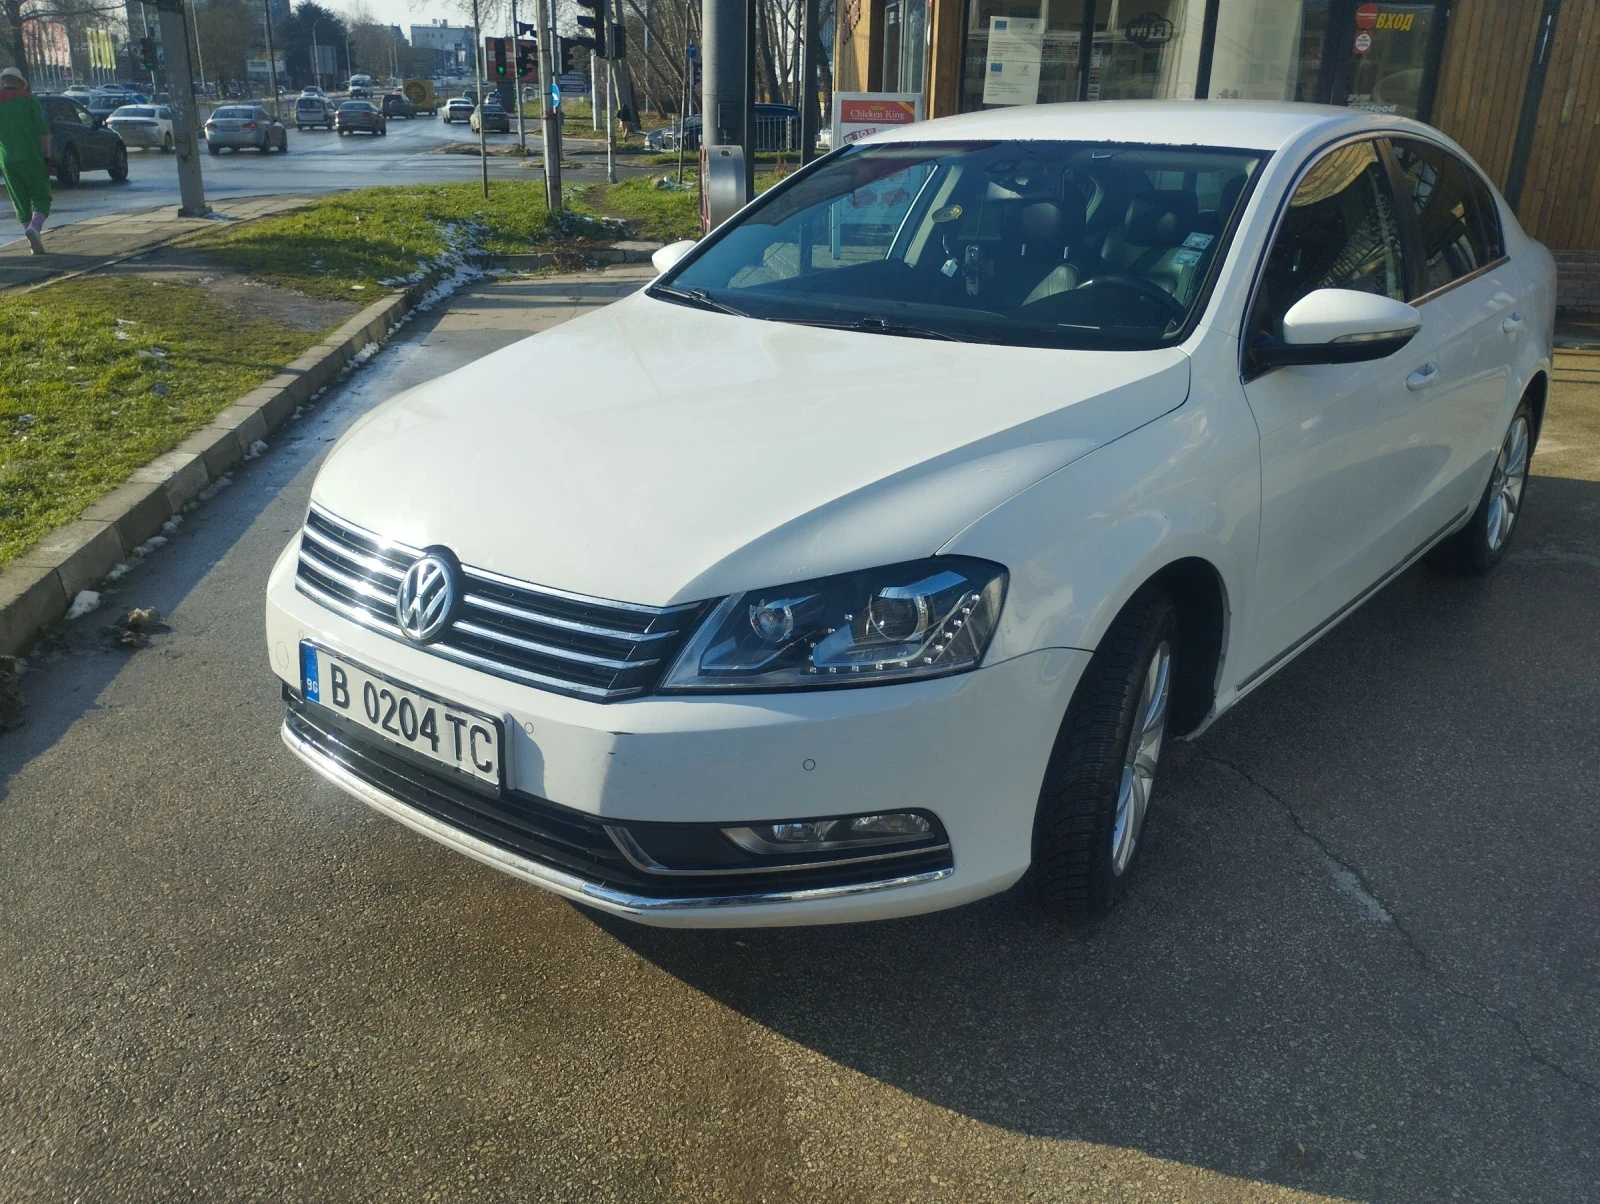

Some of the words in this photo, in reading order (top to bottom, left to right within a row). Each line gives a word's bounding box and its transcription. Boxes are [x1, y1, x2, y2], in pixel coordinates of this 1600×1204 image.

[1375, 13, 1415, 31] ВХОД
[850, 109, 883, 118] Chicken
[885, 110, 905, 120] King
[306, 677, 318, 694] BG
[330, 662, 351, 710] B
[363, 680, 440, 753] 0204
[445, 712, 494, 773] TC
